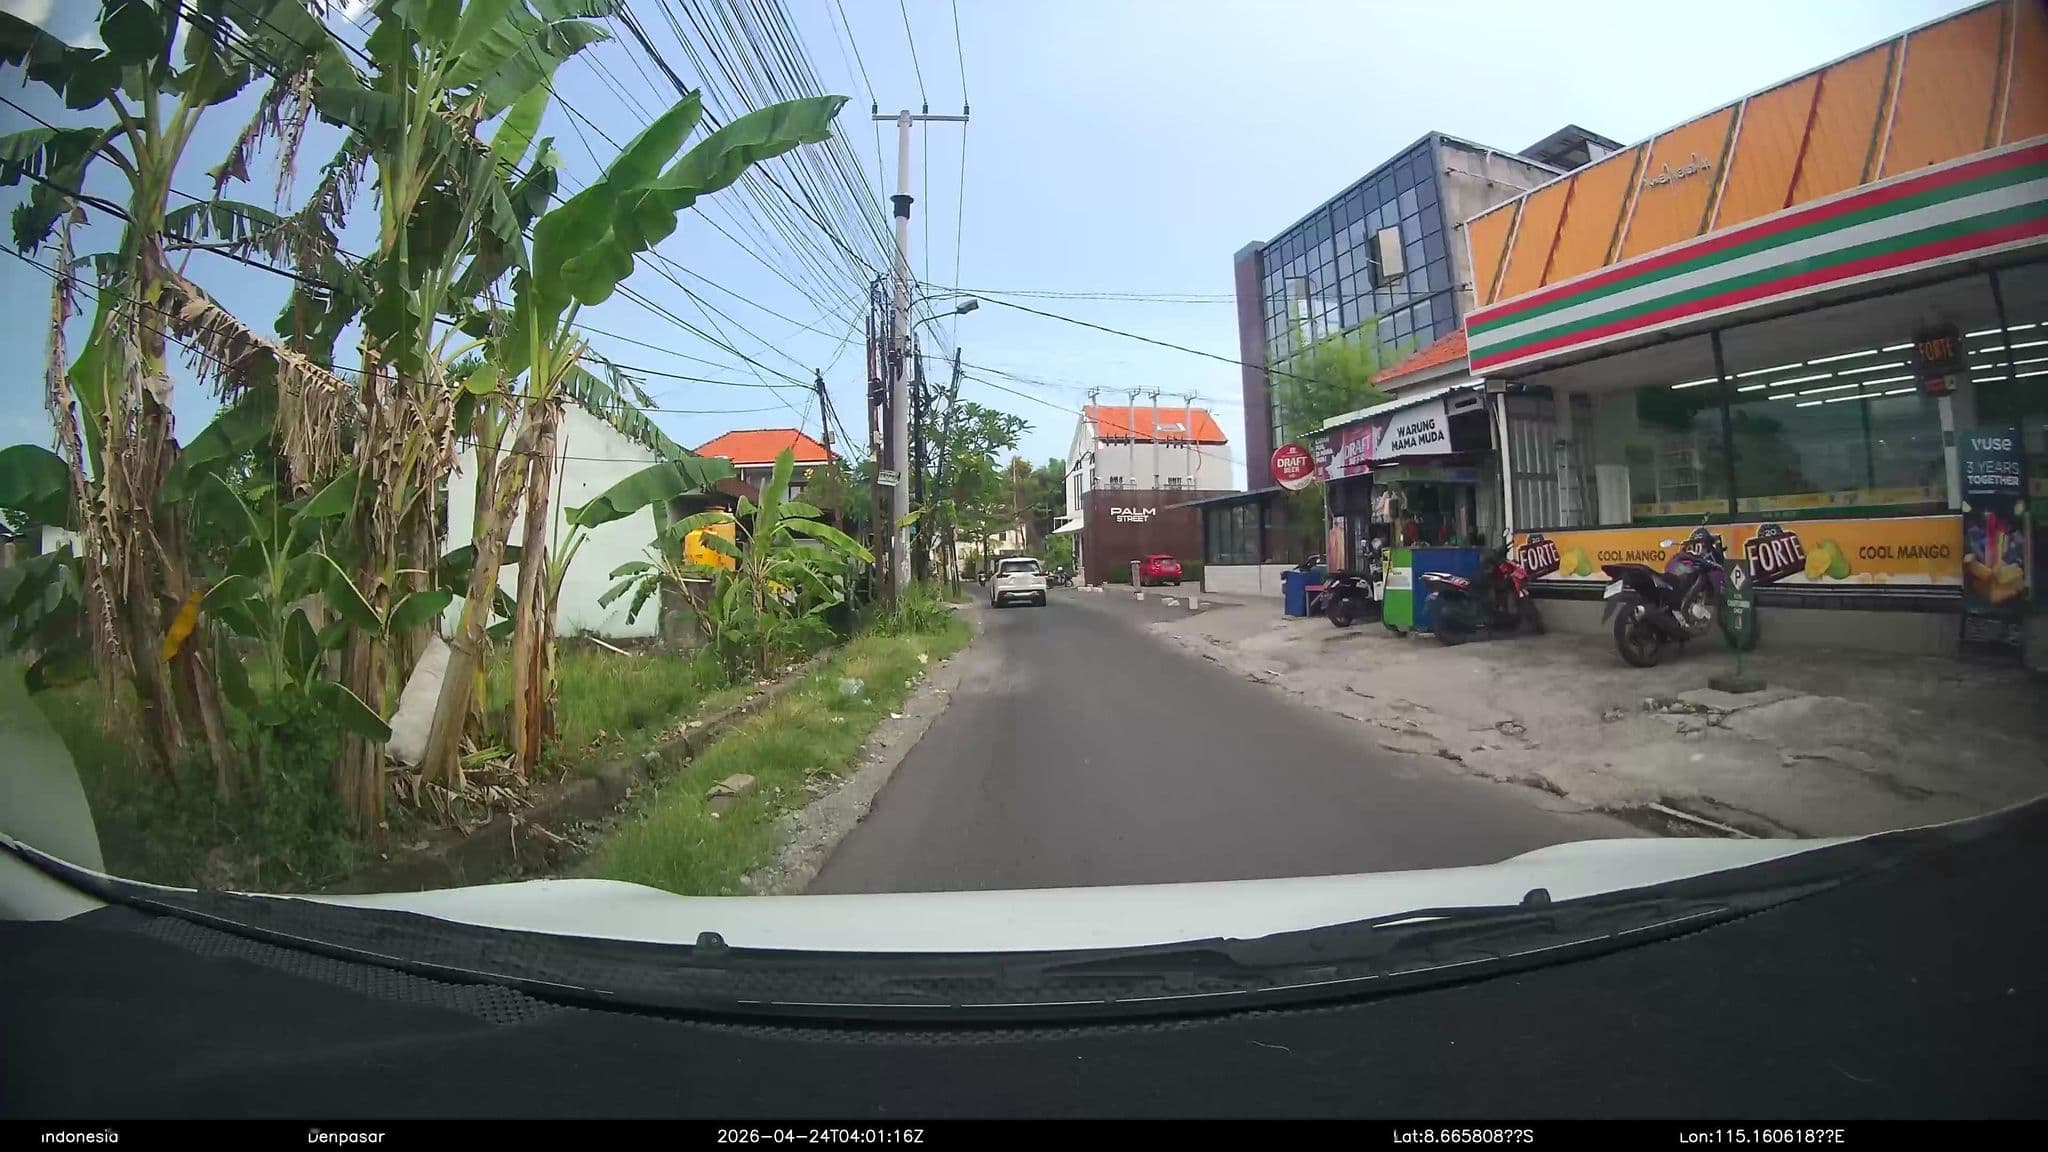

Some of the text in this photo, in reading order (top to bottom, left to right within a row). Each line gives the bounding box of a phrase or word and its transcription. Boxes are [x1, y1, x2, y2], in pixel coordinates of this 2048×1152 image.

[1397, 418, 1436, 438] WARUNG
[1344, 434, 1370, 460] DRAFT
[1391, 429, 1445, 452] MAMA MUDA
[1276, 456, 1308, 468] DRAFT
[1966, 460, 2020, 475] 3 YEARS
[1284, 466, 1300, 474] BEER
[1967, 474, 2019, 486] TOGETHER
[1110, 507, 1156, 516] PALM
[1116, 515, 1149, 523] STREET
[1765, 528, 1777, 537] 20
[1519, 543, 1559, 570] FORTE
[1598, 550, 1666, 562] COOL MANGO
[1746, 535, 1805, 576] FORTE
[1859, 544, 1950, 560] COOL MANGO
[1734, 569, 1741, 585] P
